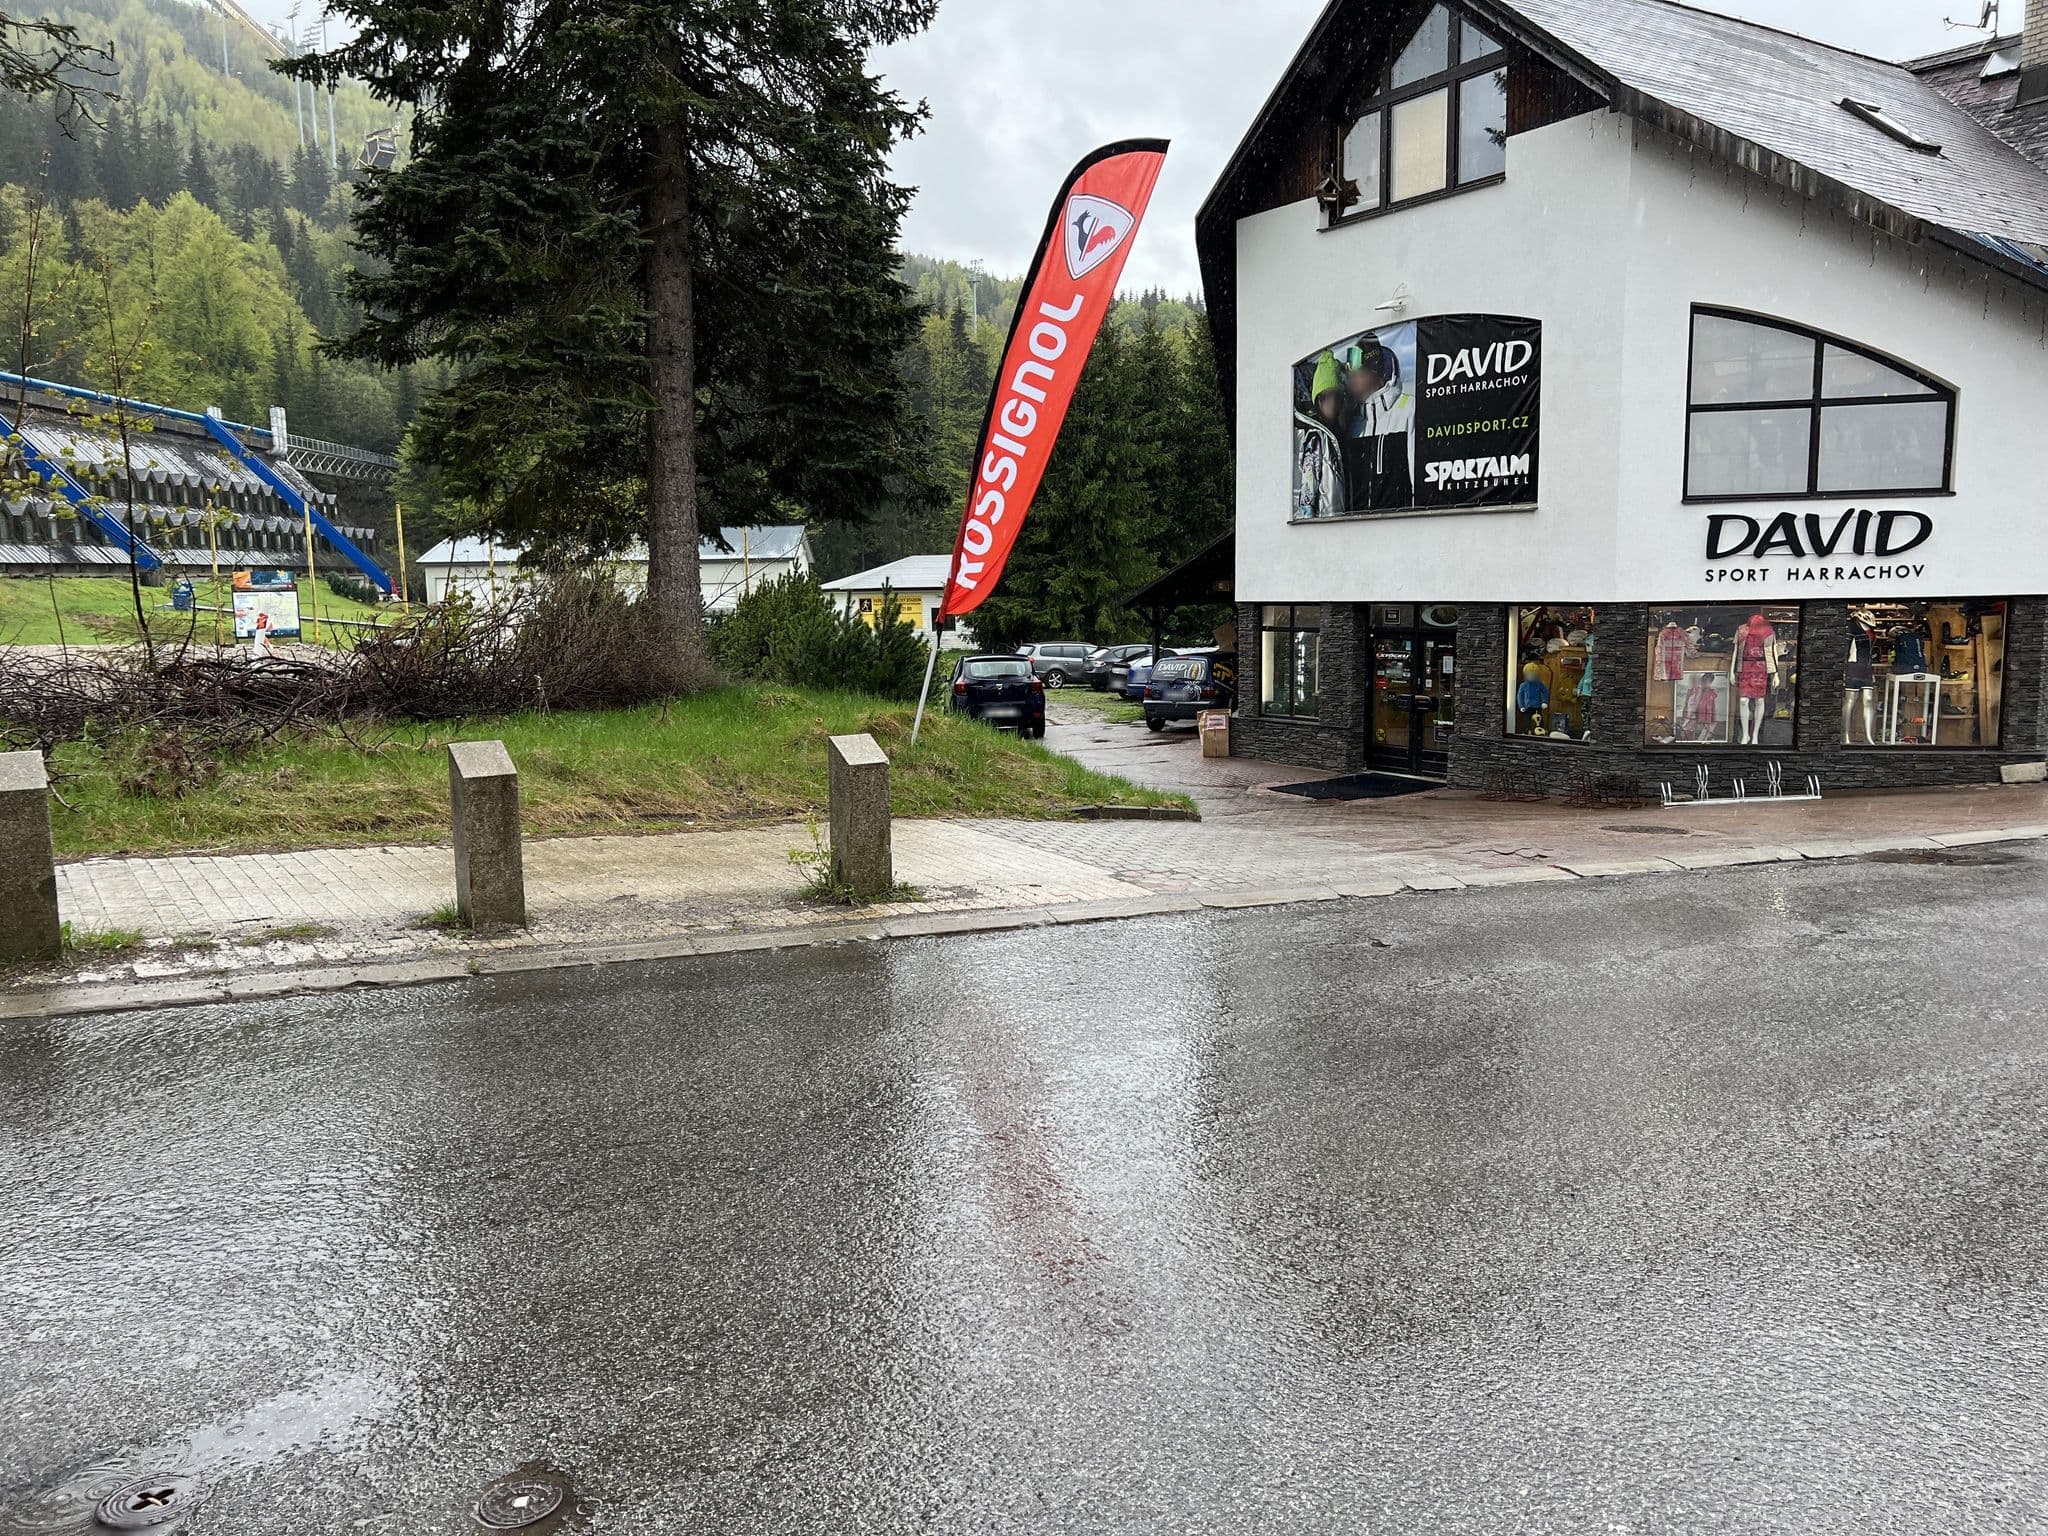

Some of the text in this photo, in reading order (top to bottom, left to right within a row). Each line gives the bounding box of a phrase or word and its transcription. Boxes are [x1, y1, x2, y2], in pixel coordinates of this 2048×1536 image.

[1427, 340, 1532, 384] DAVID
[1425, 374, 1528, 398] SPORT HARRACHOV
[955, 294, 1084, 590] ROSSIGNOL
[1427, 416, 1529, 438] DAVIDSPORT.CZ
[1424, 453, 1530, 491] SPORTALM
[1706, 508, 1933, 559] DAVID
[1705, 564, 1924, 582] SPORT HARRACHOV
[1158, 663, 1187, 671] DAVID
